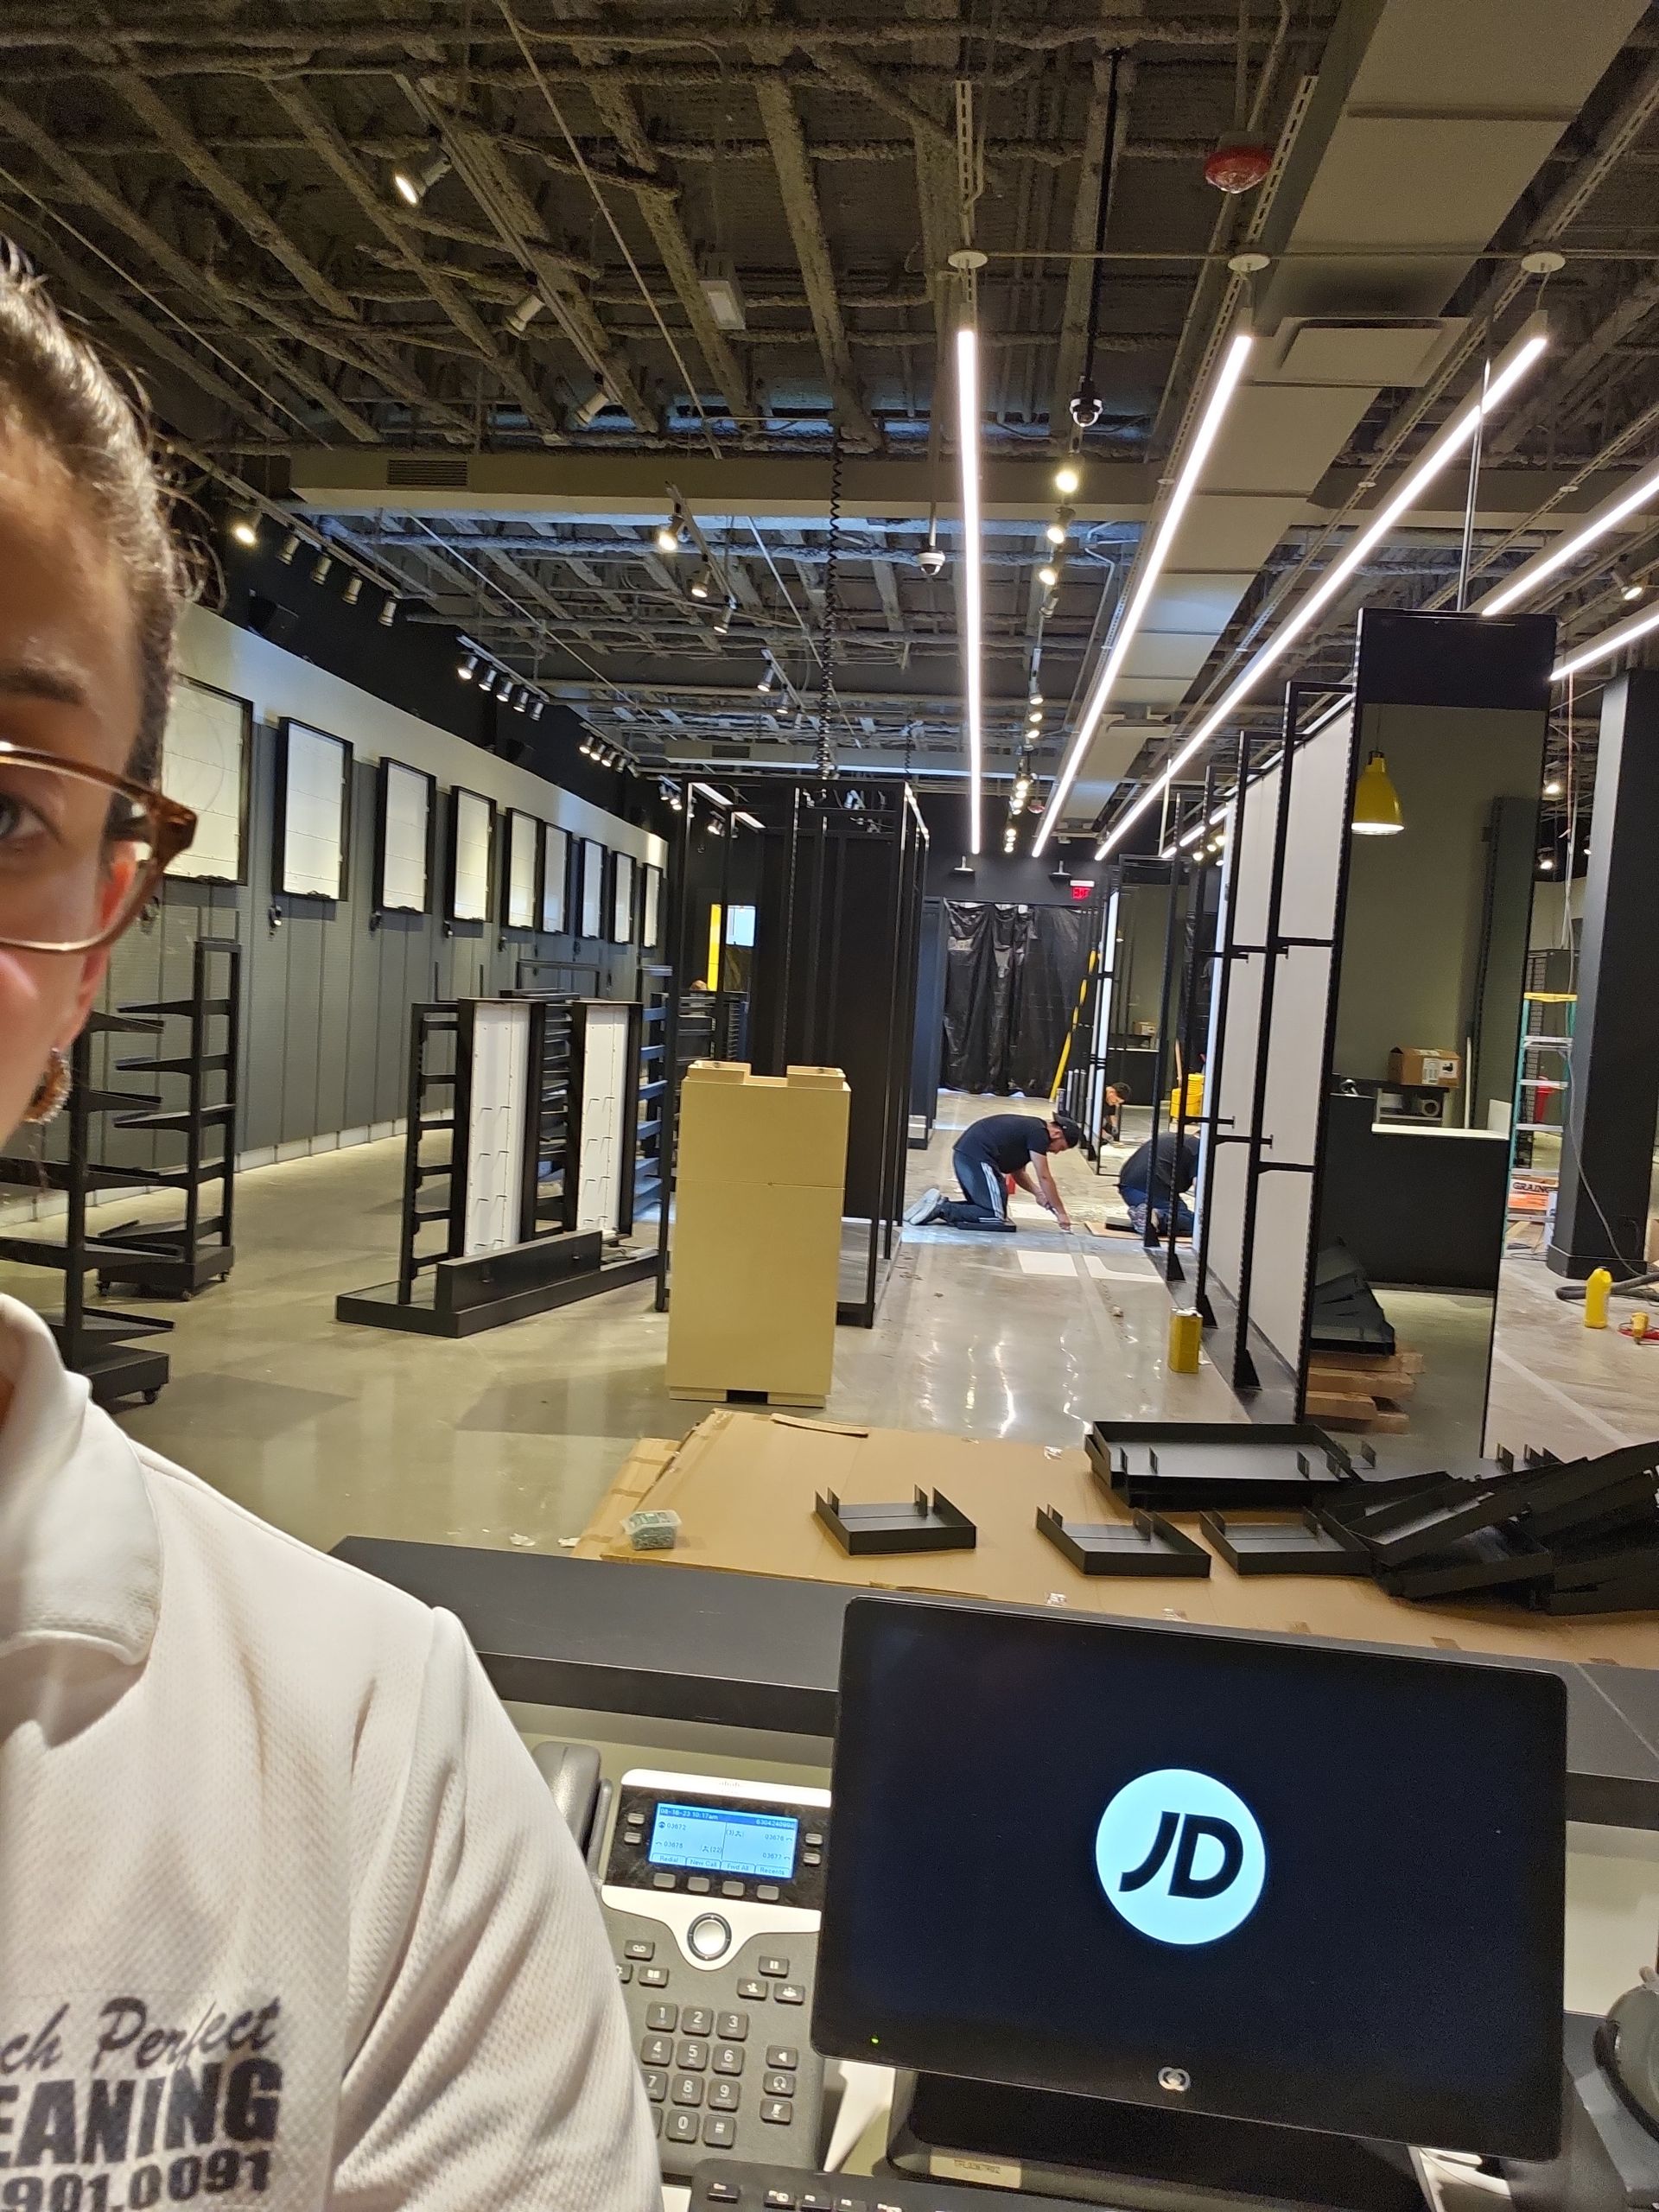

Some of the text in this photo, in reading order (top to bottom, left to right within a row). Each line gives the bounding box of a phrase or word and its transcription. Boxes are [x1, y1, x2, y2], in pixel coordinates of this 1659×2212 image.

[1118, 1810, 1244, 1899] JD
[658, 2006, 666, 2018] 1
[693, 2011, 703, 2024] 2
[728, 2015, 739, 2028] 3
[92, 1996, 281, 2071] Perfect
[652, 2041, 662, 2052] 4
[688, 2044, 698, 2057] 5
[723, 2049, 734, 2063] 6
[648, 2075, 657, 2088] 7
[683, 2080, 693, 2093] 8
[720, 2084, 730, 2097] 9
[677, 2116, 689, 2130] 0
